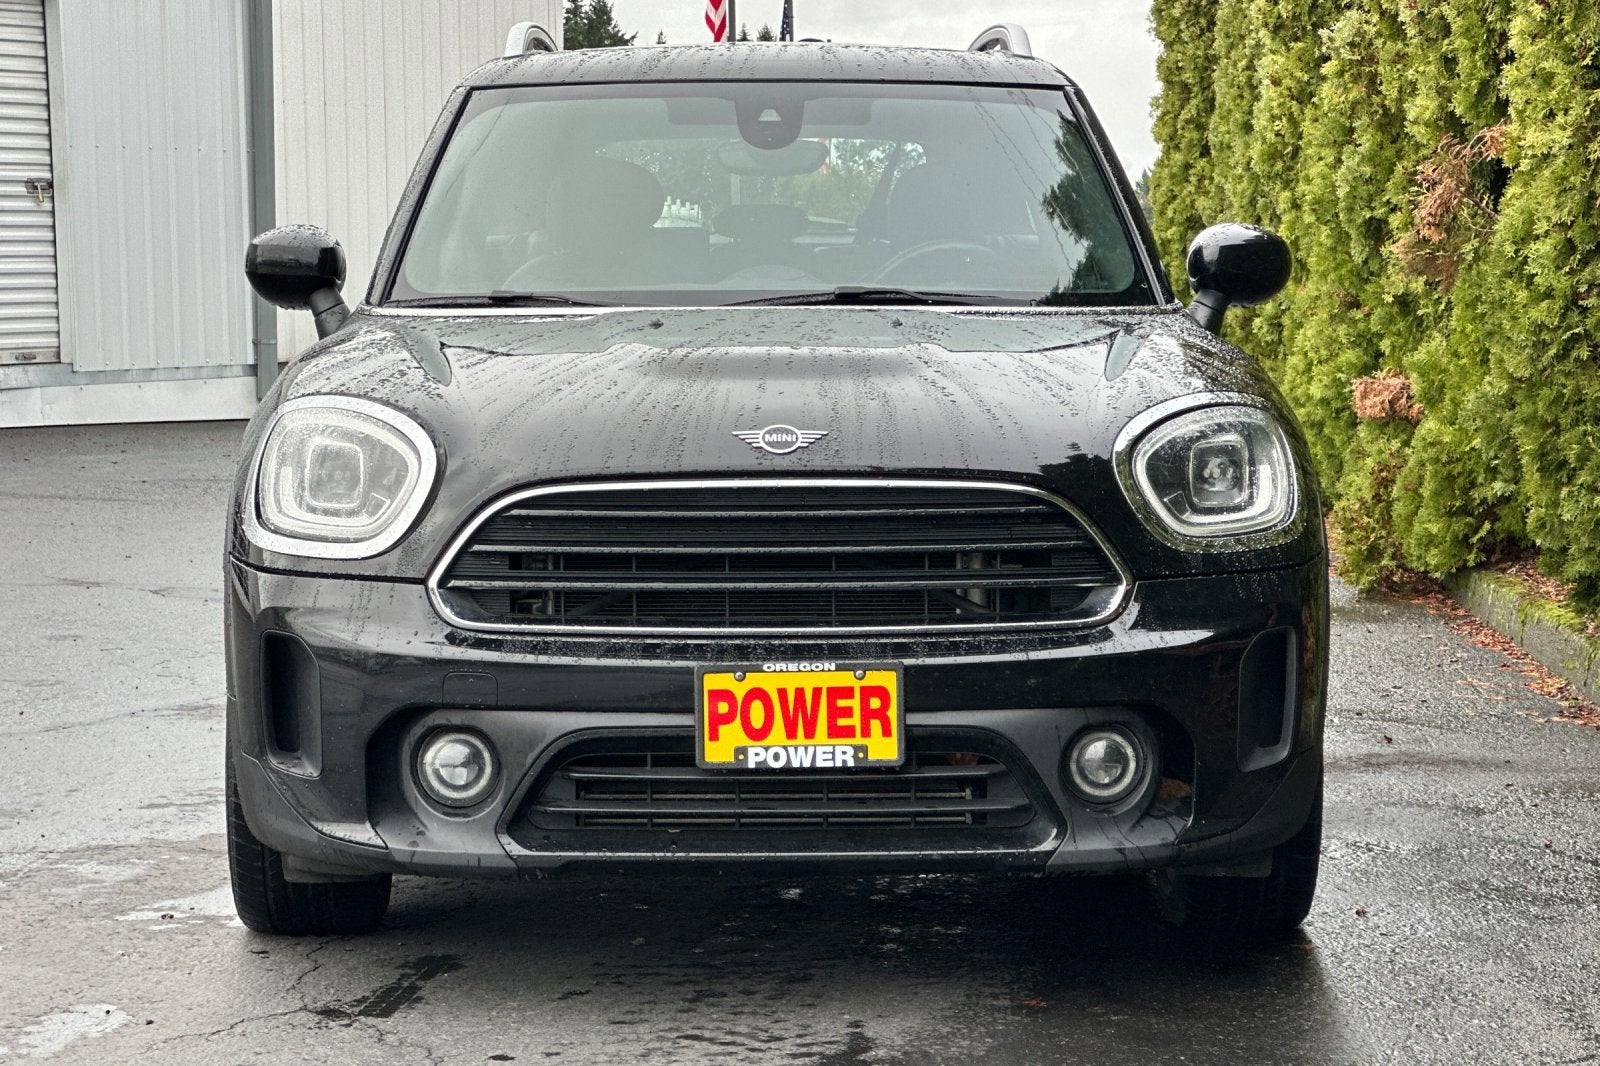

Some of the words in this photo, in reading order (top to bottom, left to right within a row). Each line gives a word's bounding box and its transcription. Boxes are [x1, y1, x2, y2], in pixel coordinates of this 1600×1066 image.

[764, 433, 797, 442] MINI
[763, 662, 836, 672] OREGON
[707, 685, 893, 742] POWER
[747, 746, 855, 768] POWER
